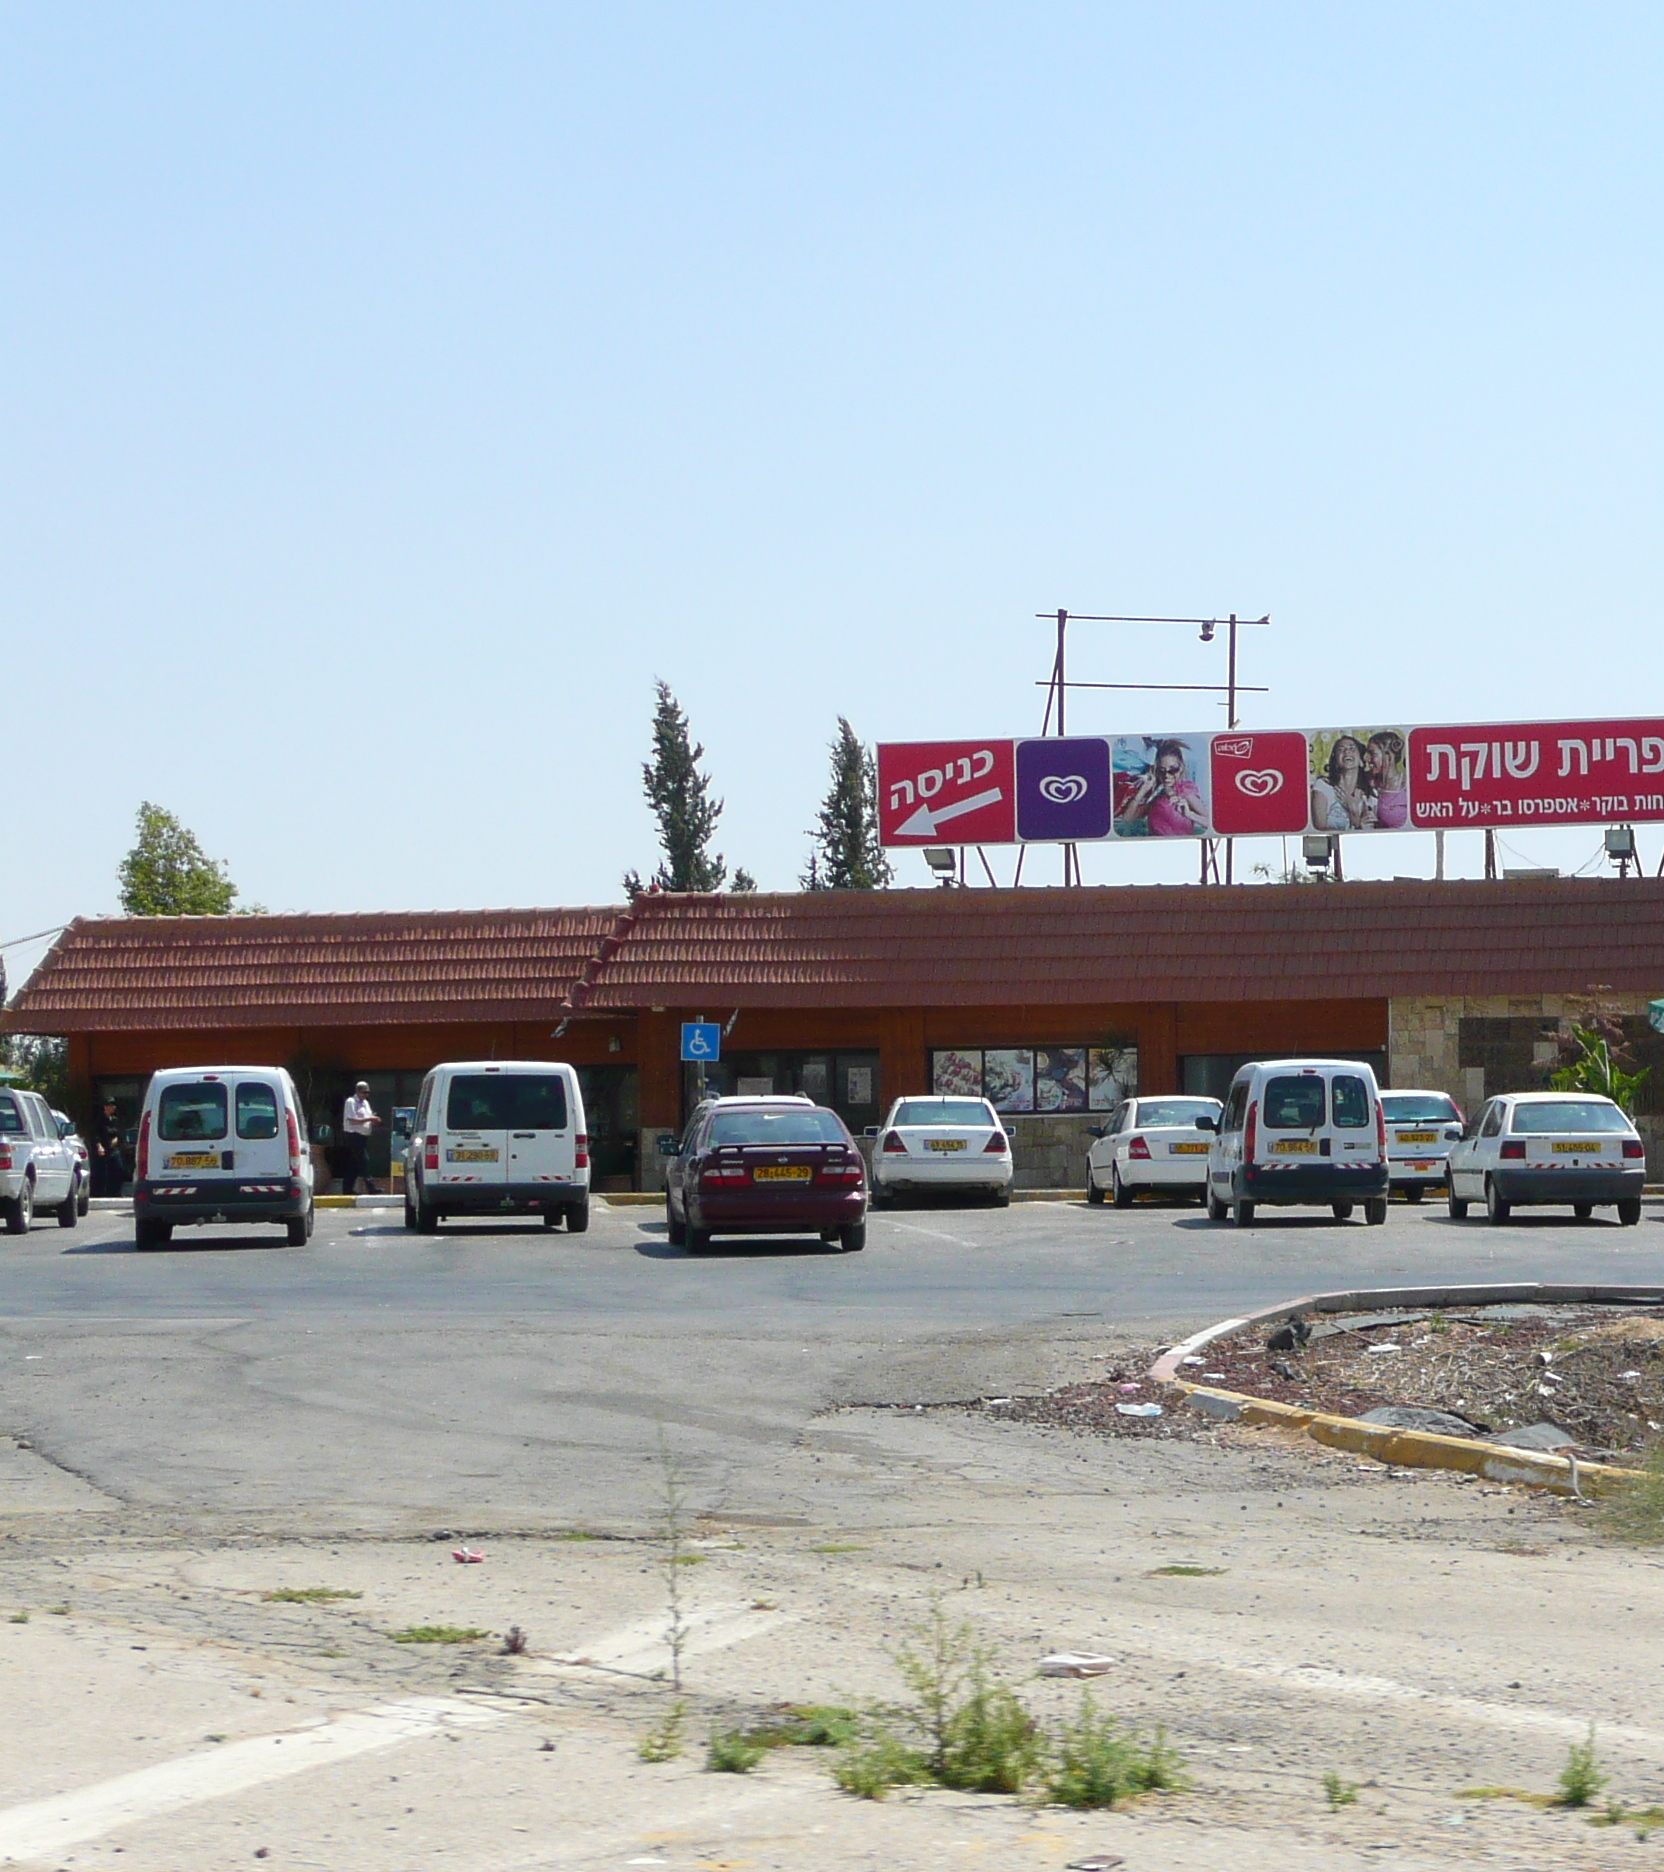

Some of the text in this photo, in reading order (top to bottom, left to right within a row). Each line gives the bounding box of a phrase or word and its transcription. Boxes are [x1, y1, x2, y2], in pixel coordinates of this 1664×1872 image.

[889, 749, 994, 811] כניסה
[1426, 740, 1540, 791] שוקת
[1416, 801, 1453, 818] האש
